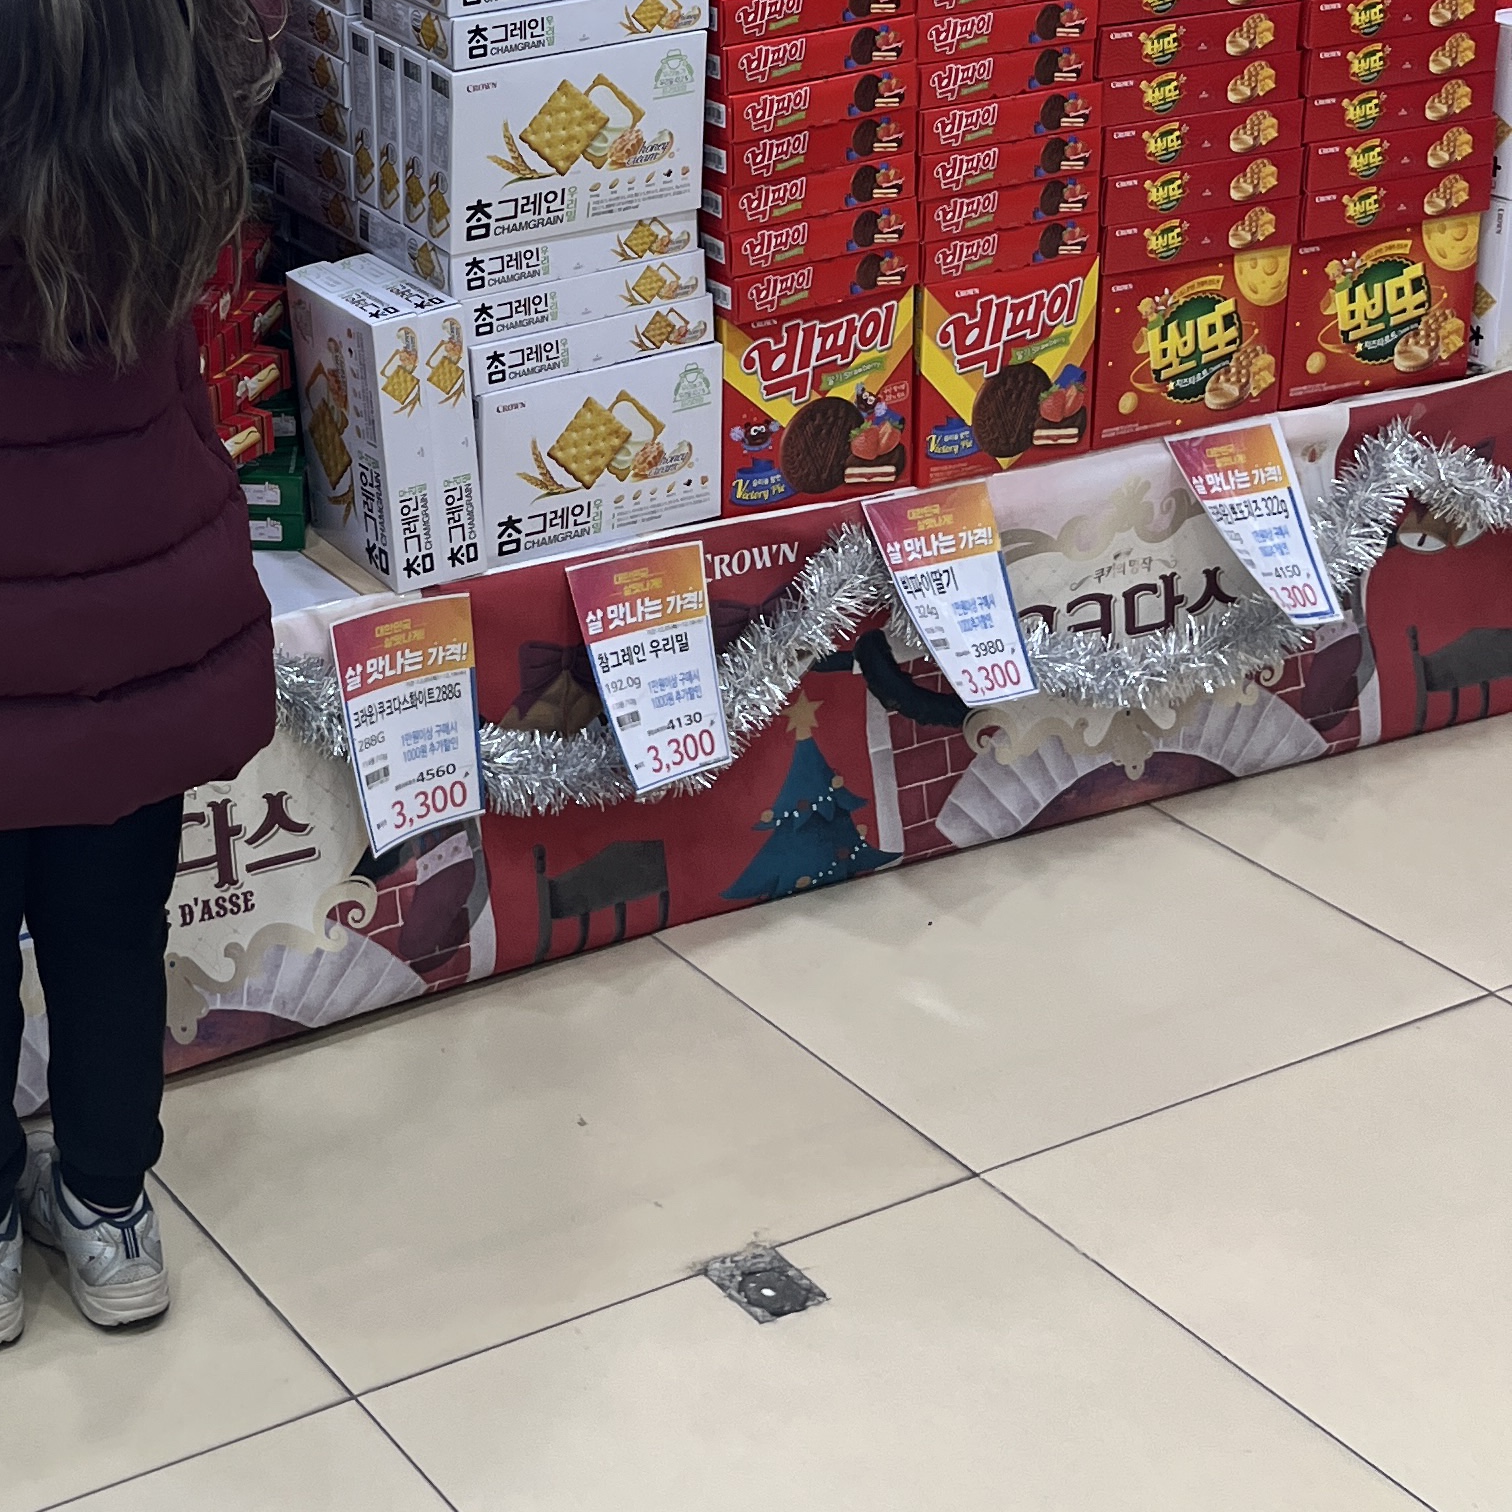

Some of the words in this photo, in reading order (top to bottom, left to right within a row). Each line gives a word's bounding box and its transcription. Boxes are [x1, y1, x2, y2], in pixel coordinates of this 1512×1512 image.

[466, 81, 498, 93] CROWN
[465, 187, 567, 242] 참그레인
[493, 213, 564, 237] CHAMGRAIN
[1335, 262, 1428, 342] 뽀또
[936, 277, 1084, 378] 빅파이
[1147, 297, 1240, 380] 뽀또
[741, 301, 898, 405] 빅파이
[496, 400, 526, 414] CROWN
[1192, 475, 1207, 495] 살
[1205, 469, 1251, 493] 맛나는
[1252, 465, 1282, 485] 가격!
[497, 501, 592, 557] 참그레인
[524, 525, 591, 550] CHAMGRAIN
[887, 541, 902, 565] 살
[903, 533, 956, 561] 맛나는
[959, 526, 993, 550] 가격!
[1274, 564, 1301, 579] 4150
[585, 609, 604, 636] 살
[606, 597, 661, 628] 맛나는
[666, 590, 703, 614] 가격!
[345, 663, 363, 692] 살
[366, 648, 423, 684] 맛나는
[427, 642, 467, 667] 가격!
[598, 644, 647, 674] 참그레인
[649, 632, 690, 659] 우리밀
[972, 639, 1005, 658] 3980
[605, 676, 642, 694] 192.0g
[962, 660, 1021, 696] 3,300
[667, 711, 702, 730] 4130
[358, 731, 385, 752] 288G
[647, 729, 715, 773] 3,300
[417, 763, 457, 783] 4560
[391, 780, 468, 829] 3,300
[179, 890, 255, 927] D'ASSE
